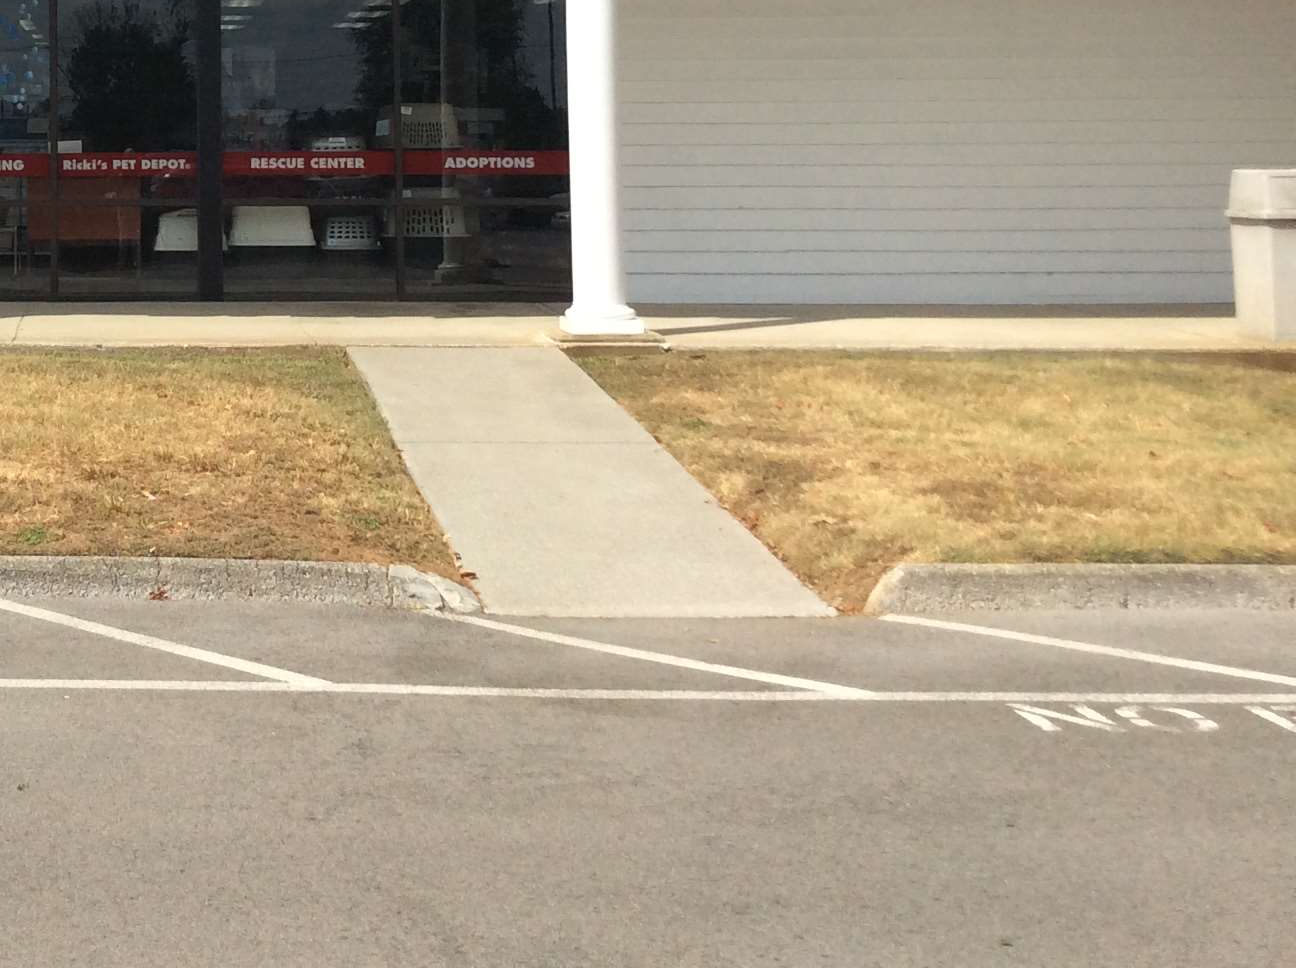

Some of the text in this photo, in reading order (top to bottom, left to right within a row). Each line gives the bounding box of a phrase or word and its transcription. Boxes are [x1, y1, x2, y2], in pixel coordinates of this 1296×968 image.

[63, 159, 187, 171] Ricki's PET DEPOT
[251, 157, 365, 169] RESCUE CENTER
[444, 156, 535, 168] ADOPTIONS
[1005, 703, 1219, 732] NO
